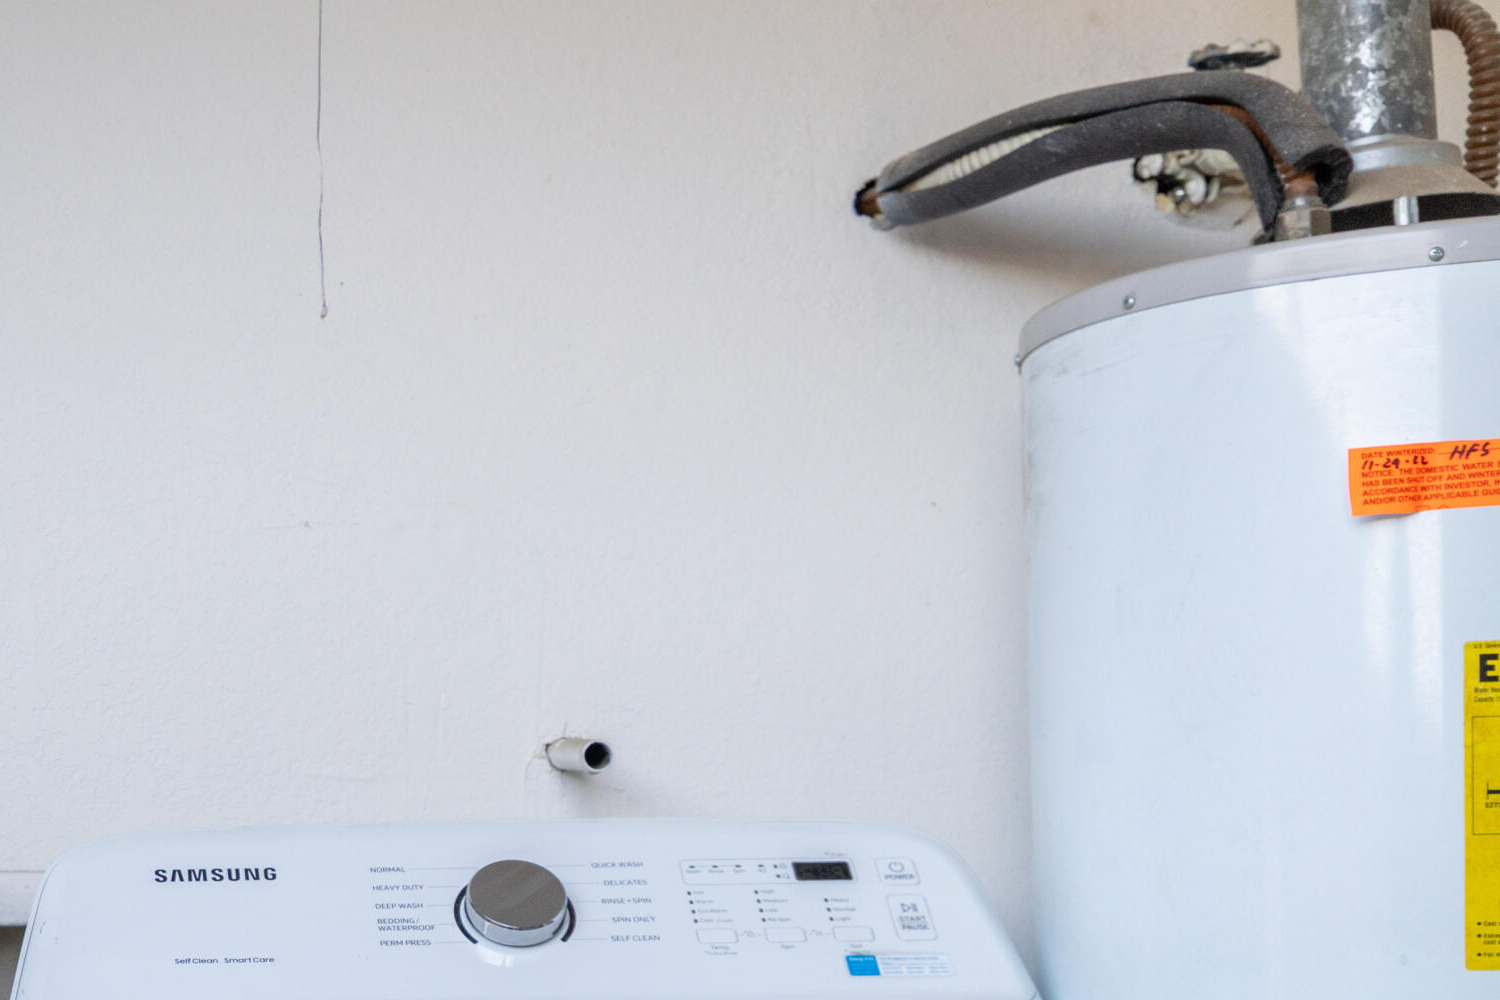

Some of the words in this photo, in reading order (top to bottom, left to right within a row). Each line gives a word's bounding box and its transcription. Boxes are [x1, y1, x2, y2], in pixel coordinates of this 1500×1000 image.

[1361, 451, 1383, 460] DATE
[1399, 467, 1413, 476] THE
[1415, 464, 1459, 474] DOMESTIC
[1462, 461, 1494, 470] WATER
[1362, 479, 1380, 488] HAS
[1382, 477, 1405, 486] BEEN
[1406, 476, 1426, 484] SHUT
[1426, 474, 1444, 483] OFF
[1446, 472, 1466, 480] AND
[1362, 485, 1419, 497] ACCORDANCE
[1420, 483, 1442, 492] WITH
[1398, 493, 1422, 503] OTHER
[1423, 489, 1480, 501] APPLICABLE
[154, 867, 277, 883] SAMSUNG
[174, 957, 191, 965] Self
